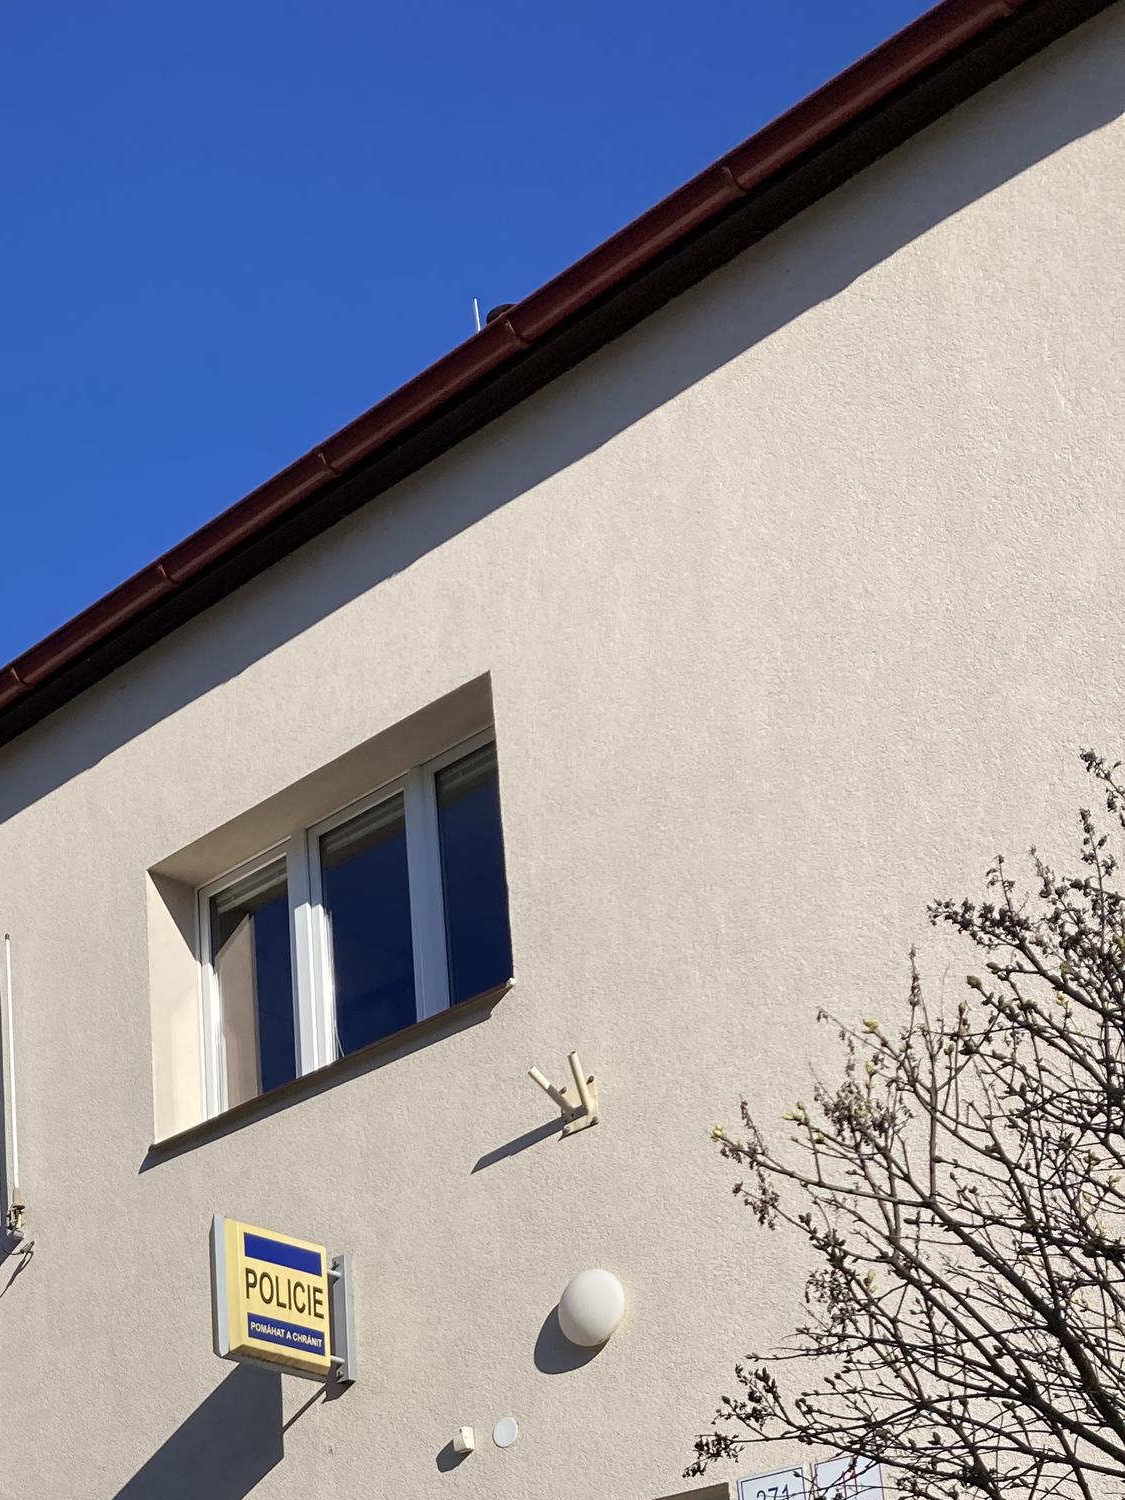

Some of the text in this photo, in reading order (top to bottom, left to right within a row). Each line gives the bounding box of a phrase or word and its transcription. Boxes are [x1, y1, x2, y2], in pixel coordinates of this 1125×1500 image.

[245, 1268, 324, 1319] POLICIE
[250, 1321, 323, 1348] POMÁHAT A CHRÁNIT
